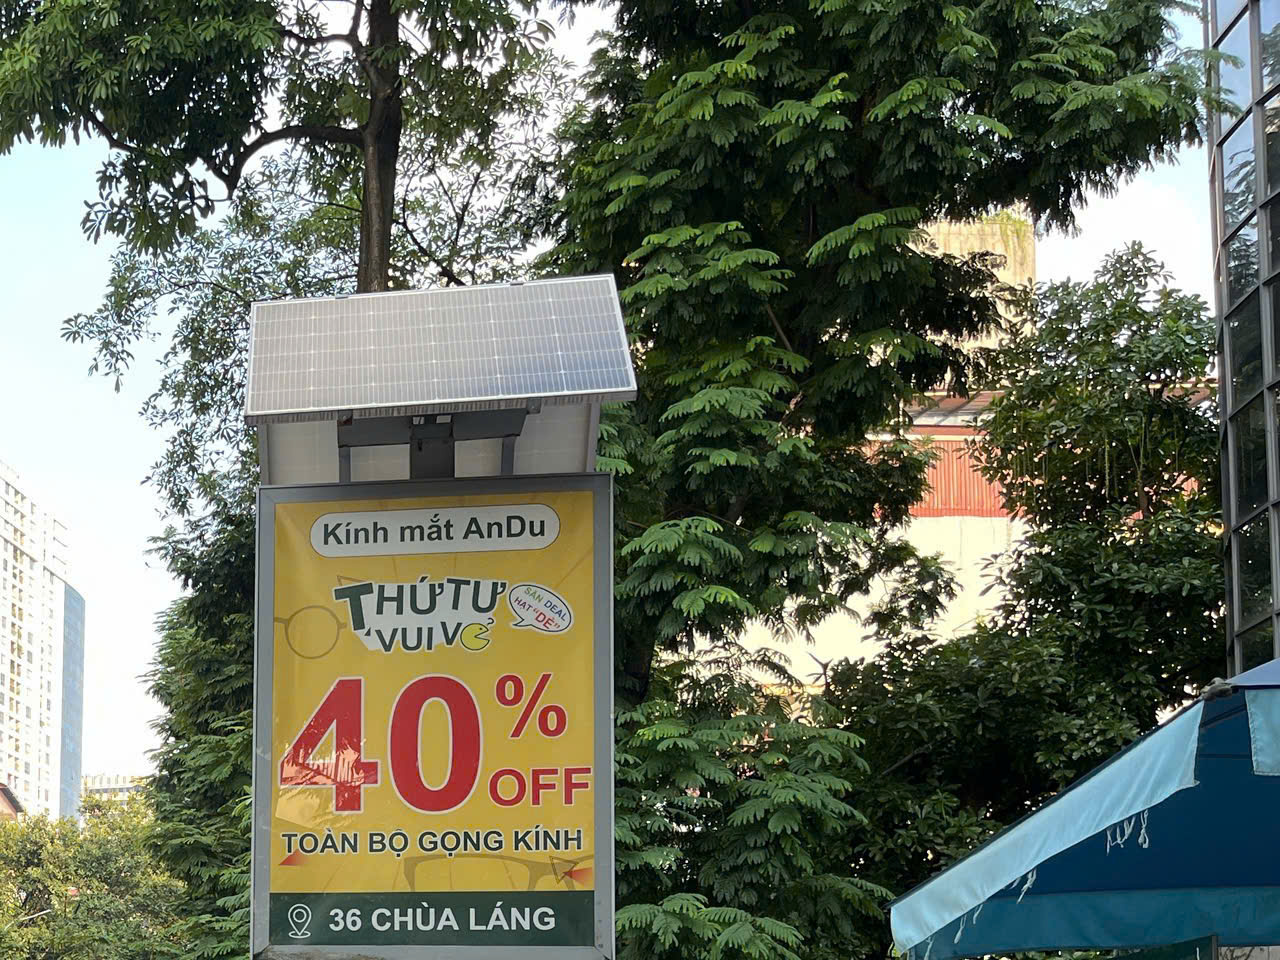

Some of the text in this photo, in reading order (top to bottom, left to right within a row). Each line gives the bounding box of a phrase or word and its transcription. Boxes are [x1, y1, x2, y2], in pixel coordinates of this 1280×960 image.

[323, 513, 546, 546] Kính mắt AnDu
[543, 600, 567, 622] DEAL
[375, 627, 433, 652] VUI
[489, 767, 591, 807] OFF
[281, 825, 583, 859] TOÀN BỘ GỌNG KÍNH
[328, 900, 557, 933] 36 CHÙA LÁNG
